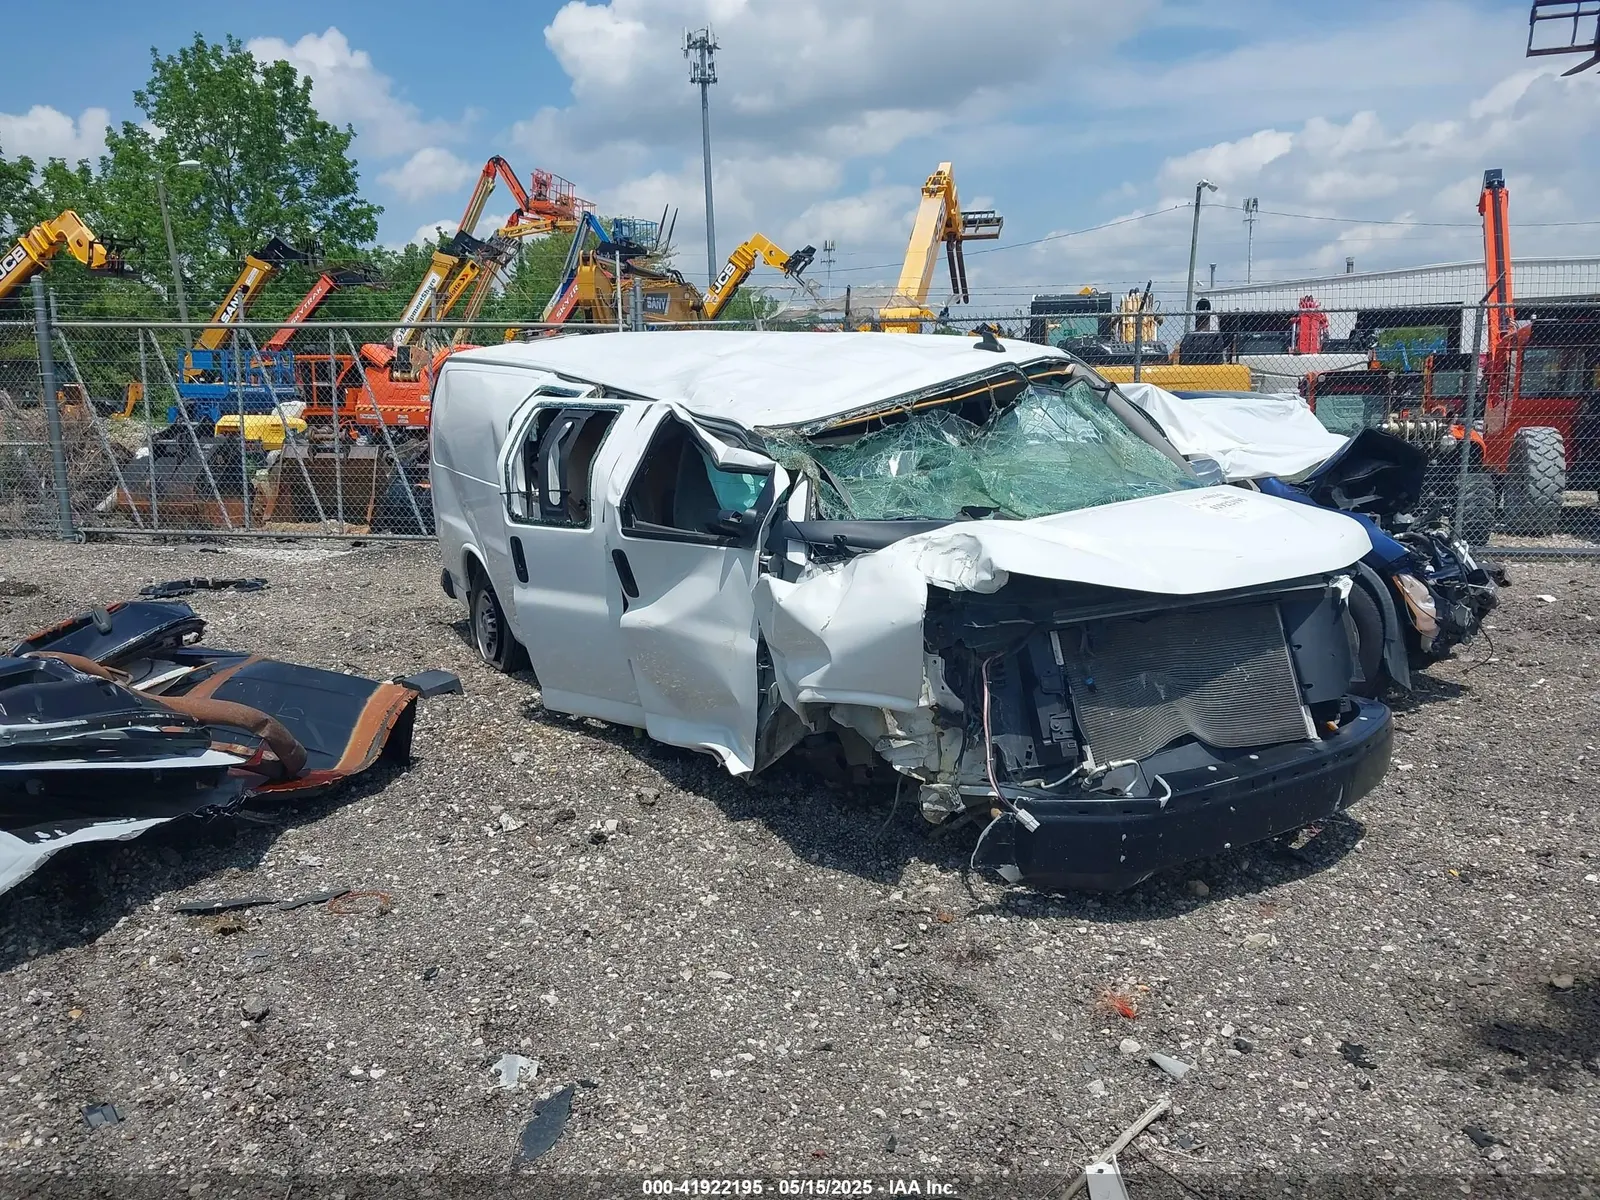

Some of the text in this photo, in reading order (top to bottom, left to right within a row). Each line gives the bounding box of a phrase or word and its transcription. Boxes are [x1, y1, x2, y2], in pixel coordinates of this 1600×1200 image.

[0, 245, 27, 280] JCB
[714, 262, 737, 294] JCB
[220, 287, 246, 324] SAN
[400, 278, 437, 335] EipmentShare
[646, 296, 668, 310] SANY
